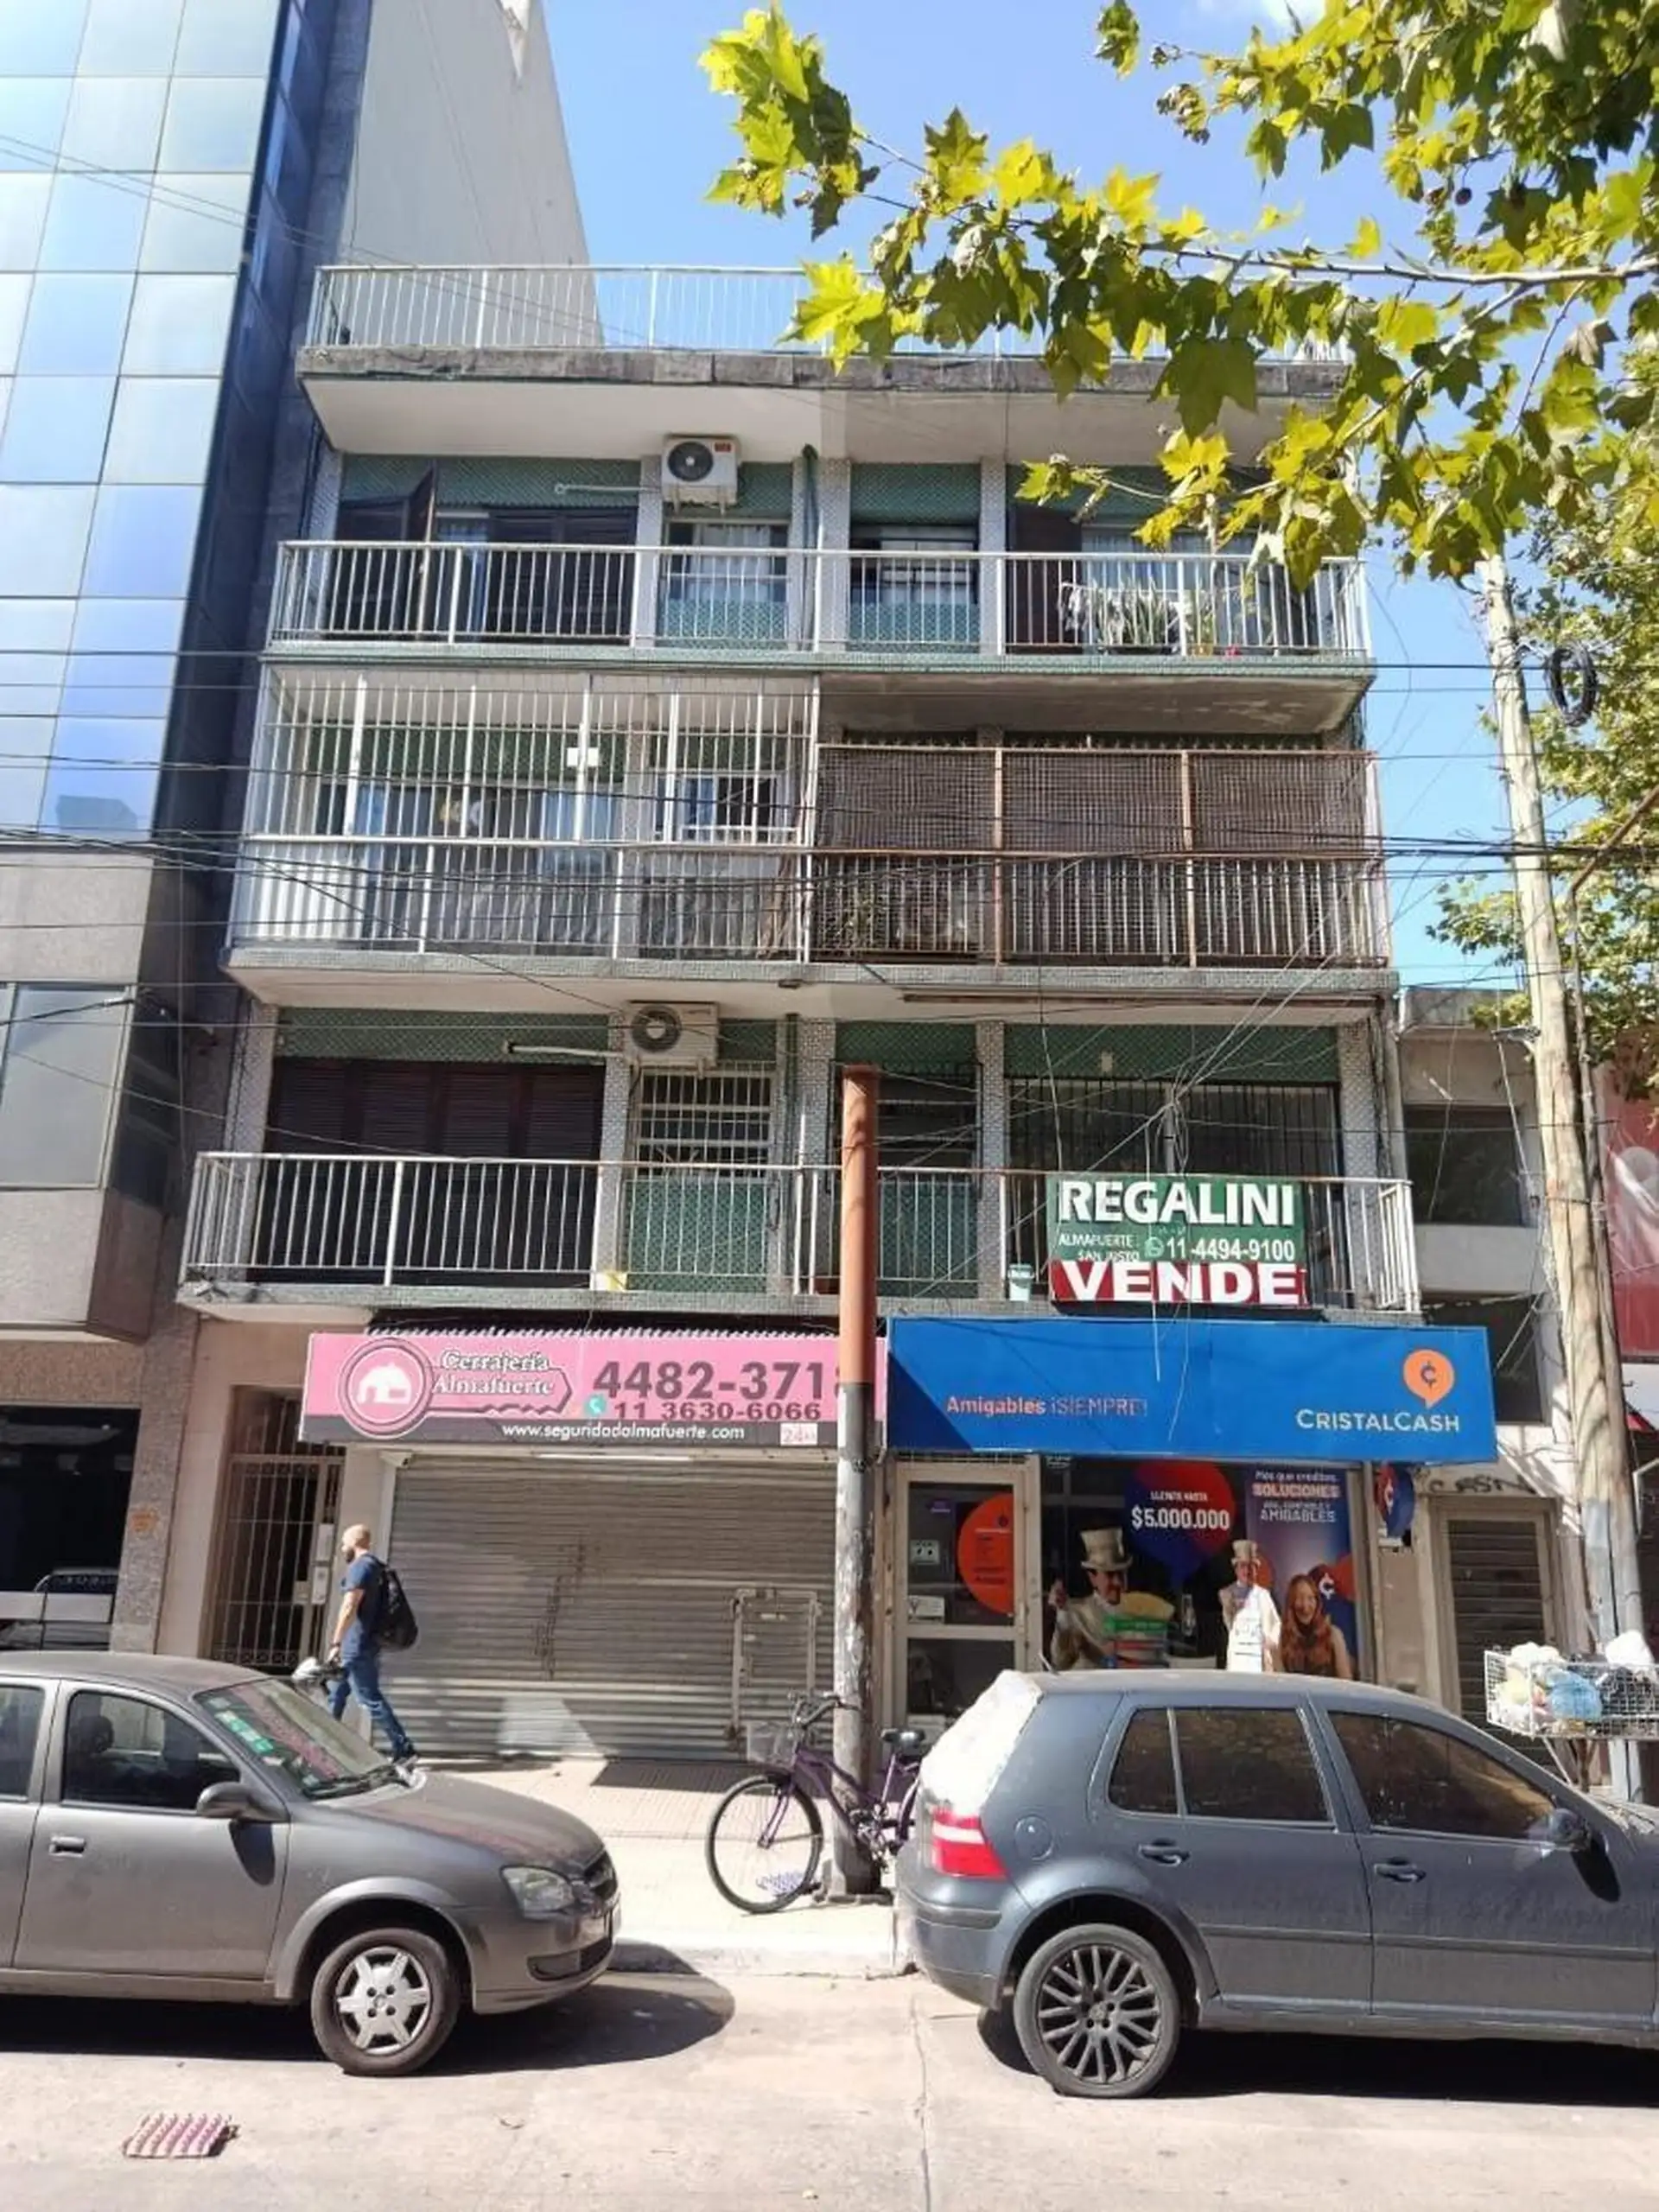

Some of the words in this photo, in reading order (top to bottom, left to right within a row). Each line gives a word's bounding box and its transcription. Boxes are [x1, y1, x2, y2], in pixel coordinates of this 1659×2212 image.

[1059, 1179, 1295, 1225] REGALINI
[1061, 1261, 1300, 1304] VENDE
[442, 1349, 550, 1372] Cerrajería
[432, 1375, 555, 1395] Almafuerte
[593, 1361, 841, 1400] 4482-371
[614, 1402, 645, 1419] 11
[660, 1402, 822, 1421] 3630-6066
[946, 1396, 1046, 1418] Amigables
[1296, 1408, 1460, 1433] CRISTALCASH
[1252, 1483, 1341, 1497] SOLUCIONES
[1131, 1504, 1230, 1530] $5.000.000
